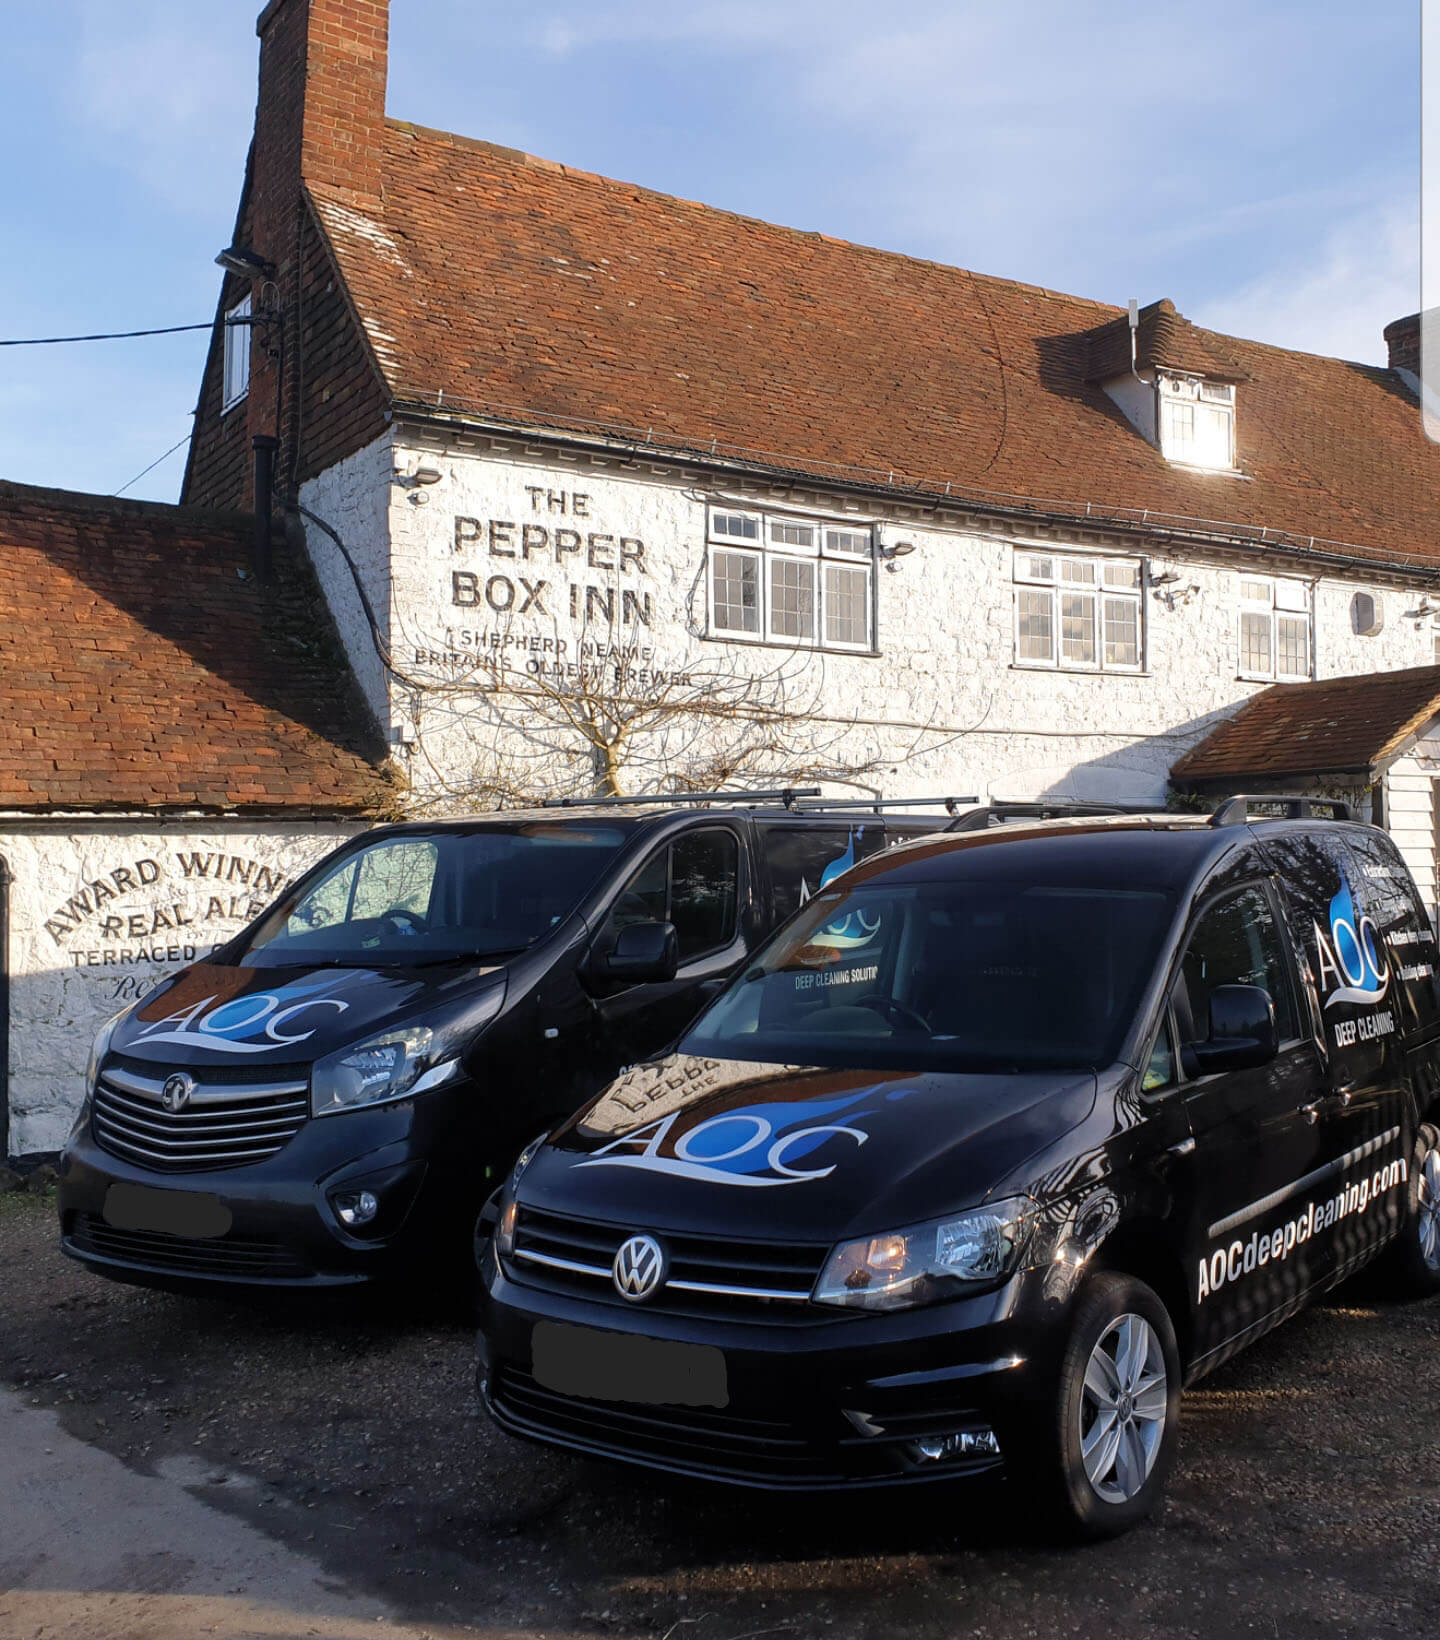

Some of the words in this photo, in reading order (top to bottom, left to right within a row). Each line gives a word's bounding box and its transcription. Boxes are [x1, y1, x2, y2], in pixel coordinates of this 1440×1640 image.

[524, 485, 593, 516] THE
[453, 515, 648, 574] PEPPER
[452, 570, 549, 615] BOX
[569, 583, 650, 626] INN
[461, 630, 568, 654] SHEPHERD
[581, 642, 652, 661] NEAME
[526, 659, 602, 679] OLDEST
[44, 858, 161, 947] AWARD
[100, 902, 193, 939] REAL
[69, 945, 196, 967] TERRACED
[1312, 915, 1390, 993] AOC
[795, 974, 815, 990] DEEP
[816, 969, 850, 987] CLEANING
[137, 994, 350, 1042] AOC
[1335, 1020, 1356, 1047] DEEP
[1358, 1010, 1394, 1041] CLEANING
[588, 1110, 869, 1178] AOC
[1198, 1158, 1408, 1305] AOCdeepcleaning.com
